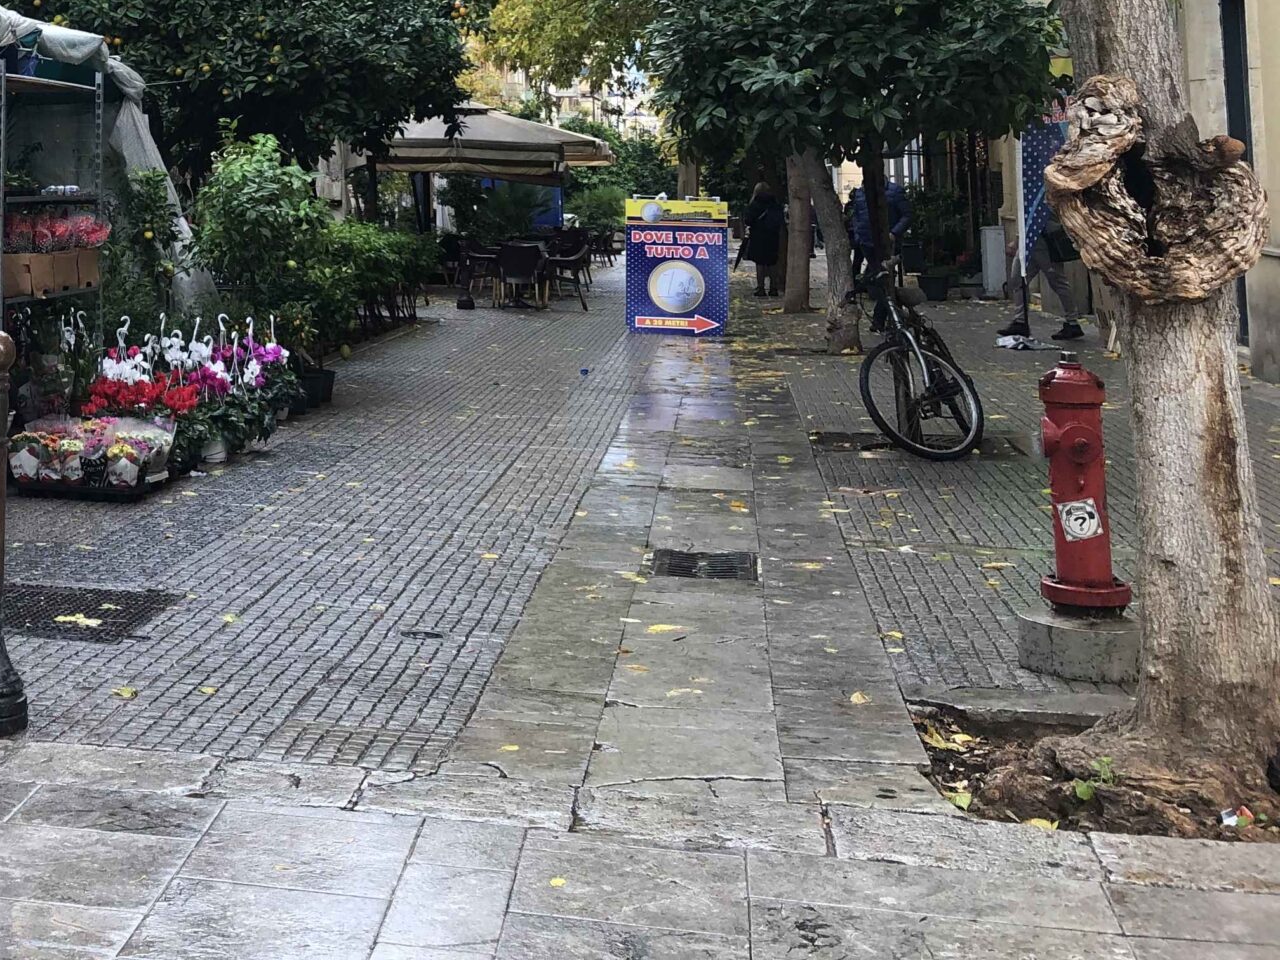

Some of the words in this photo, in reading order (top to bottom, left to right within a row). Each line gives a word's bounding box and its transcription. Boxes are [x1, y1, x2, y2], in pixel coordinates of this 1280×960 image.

[631, 231, 672, 243] DOVE
[676, 232, 722, 245] TROVI
[645, 245, 693, 258] TUTTO
[696, 246, 709, 259] A
[664, 319, 688, 327] METRI
